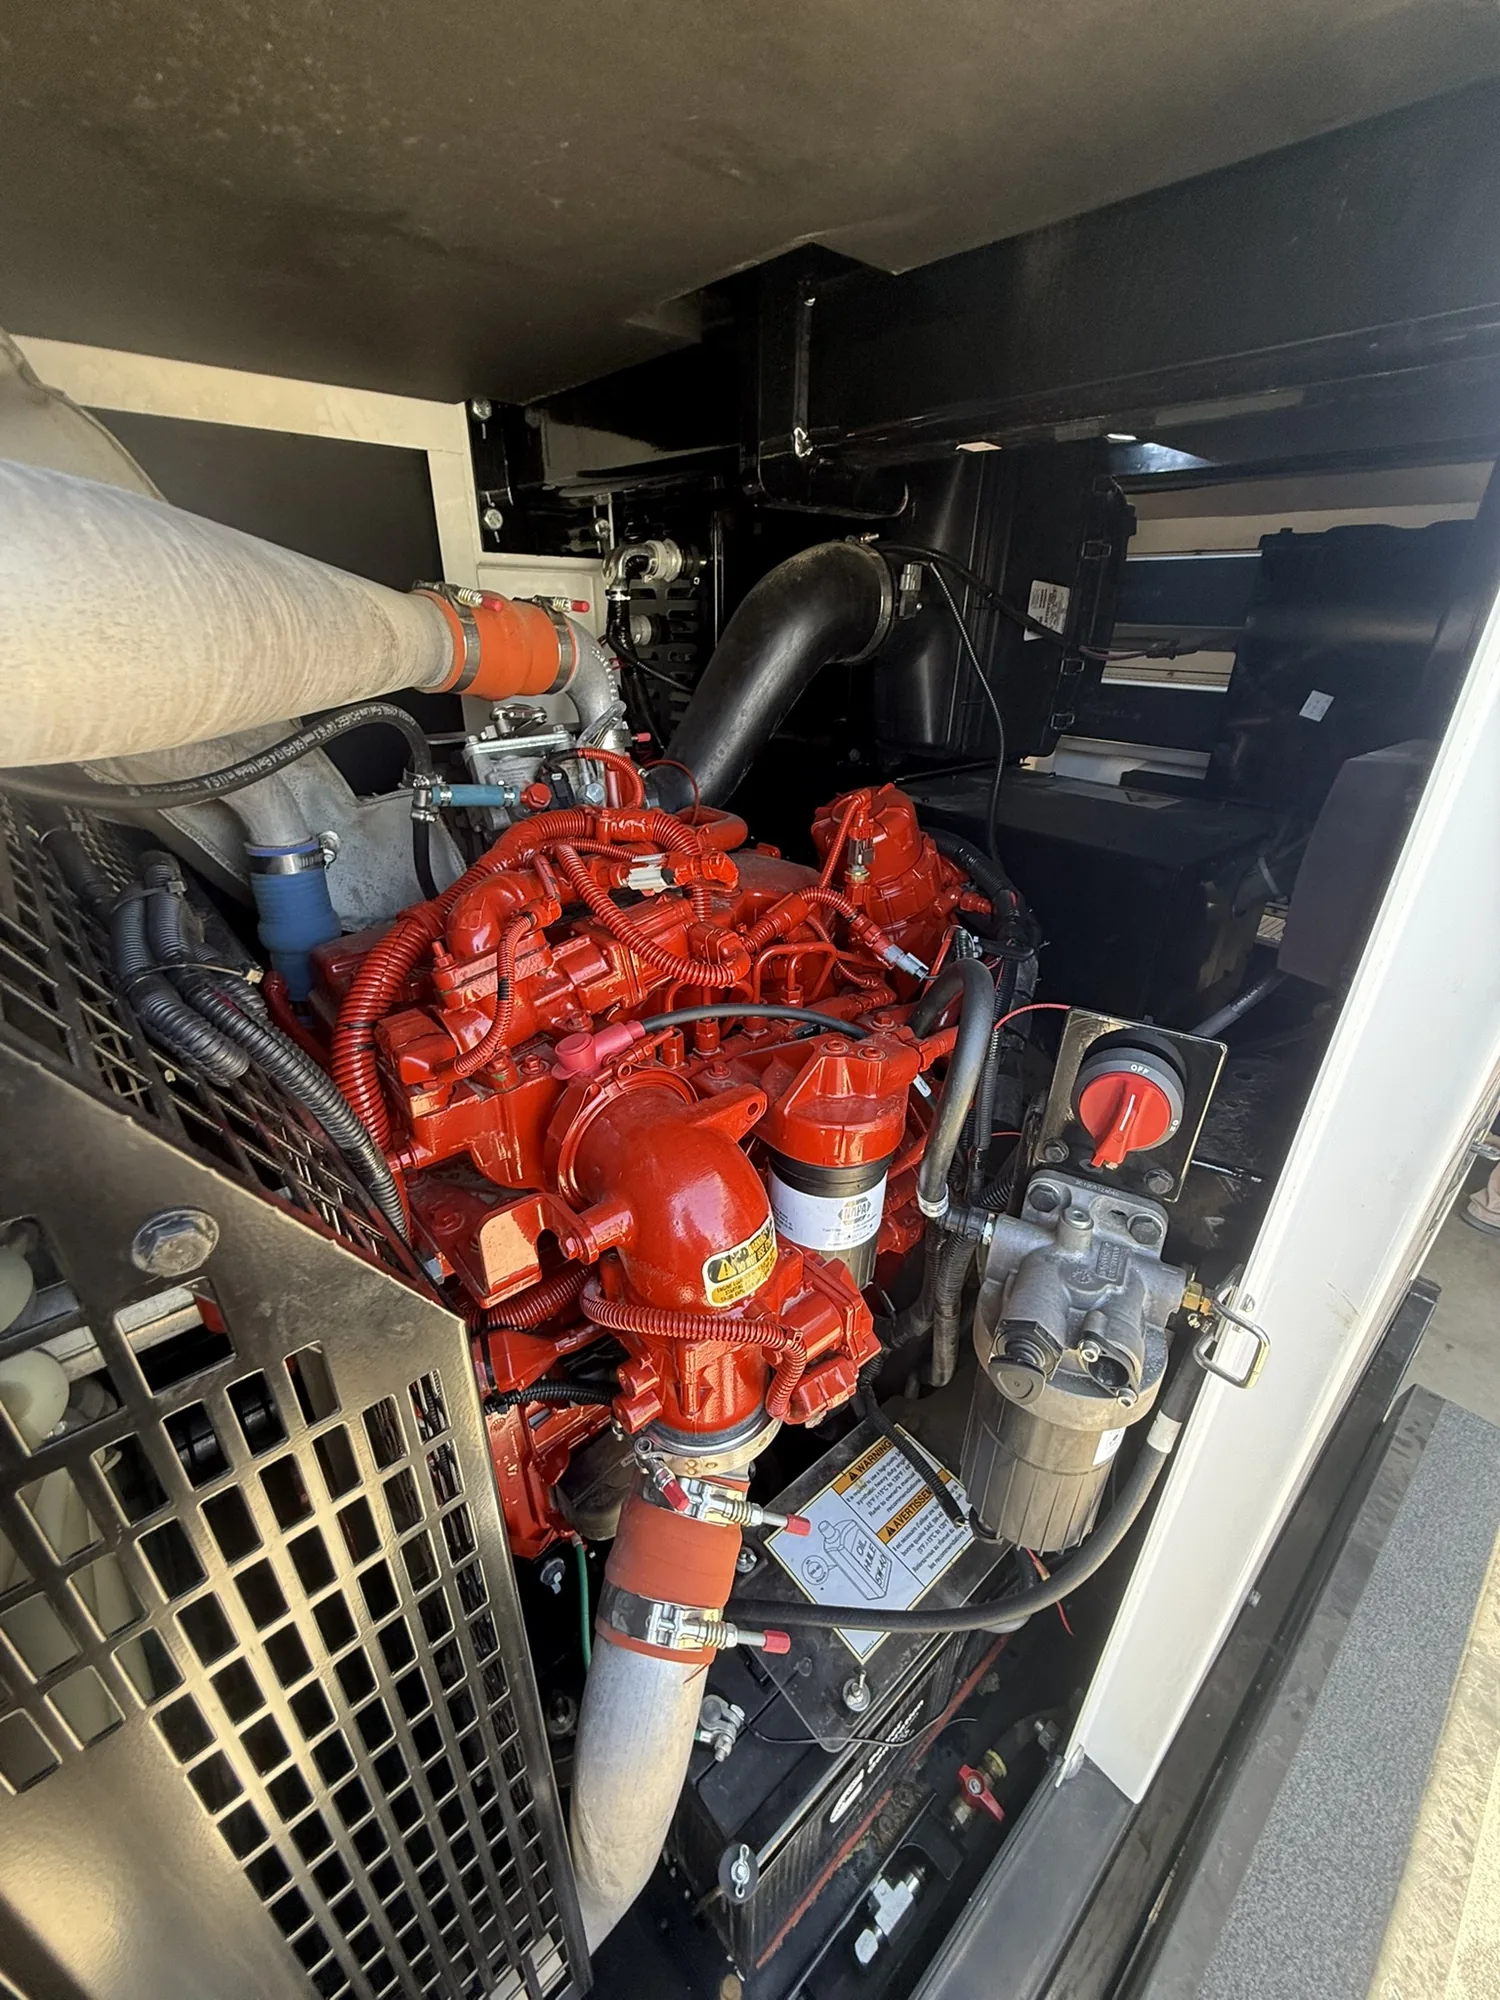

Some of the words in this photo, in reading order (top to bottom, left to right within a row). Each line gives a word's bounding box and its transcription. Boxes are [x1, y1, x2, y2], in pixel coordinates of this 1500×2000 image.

[1130, 1064, 1150, 1075] OFF
[1170, 1119, 1180, 1132] ON
[855, 1439, 892, 1474] WARNING
[856, 1486, 876, 1506] synthetic
[874, 1475, 889, 1488] heavy
[886, 1467, 898, 1477] duty
[868, 1504, 882, 1517] Refer
[885, 1485, 902, 1502] owner's
[900, 1471, 916, 1487] manual
[856, 1540, 867, 1556] OIL
[901, 1543, 914, 1556] bonne
[924, 1521, 934, 1532] SAE
[863, 1543, 876, 1572] HUILE
[875, 1554, 886, 1585] 5W-40
